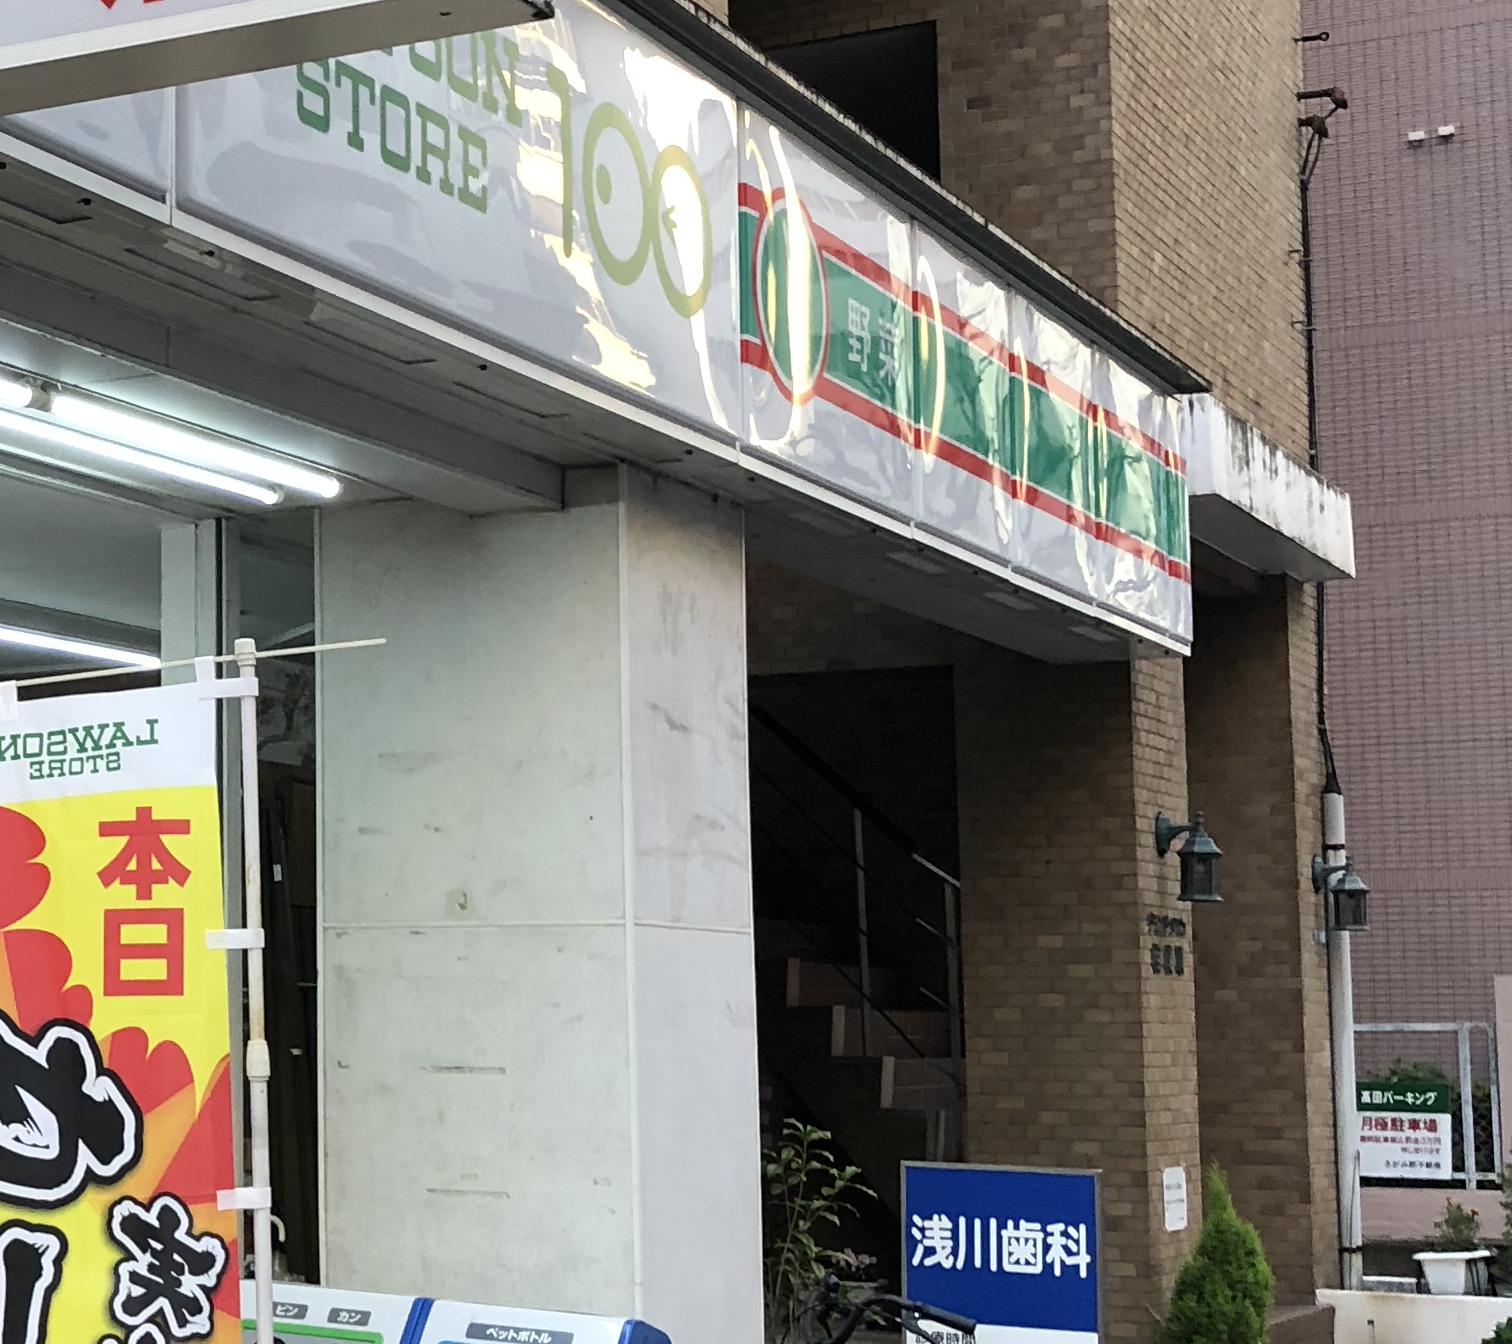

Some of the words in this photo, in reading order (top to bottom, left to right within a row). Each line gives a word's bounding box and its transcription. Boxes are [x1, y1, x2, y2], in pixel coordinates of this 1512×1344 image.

[295, 58, 489, 215] STORE
[545, 62, 714, 320] 100
[1361, 1116, 1438, 1133] 月極駐車場
[910, 1212, 1091, 1279] 浅川歯科
[275, 1303, 300, 1317] ビン
[337, 1309, 363, 1324] カン
[485, 1325, 553, 1344] ペットボトル
